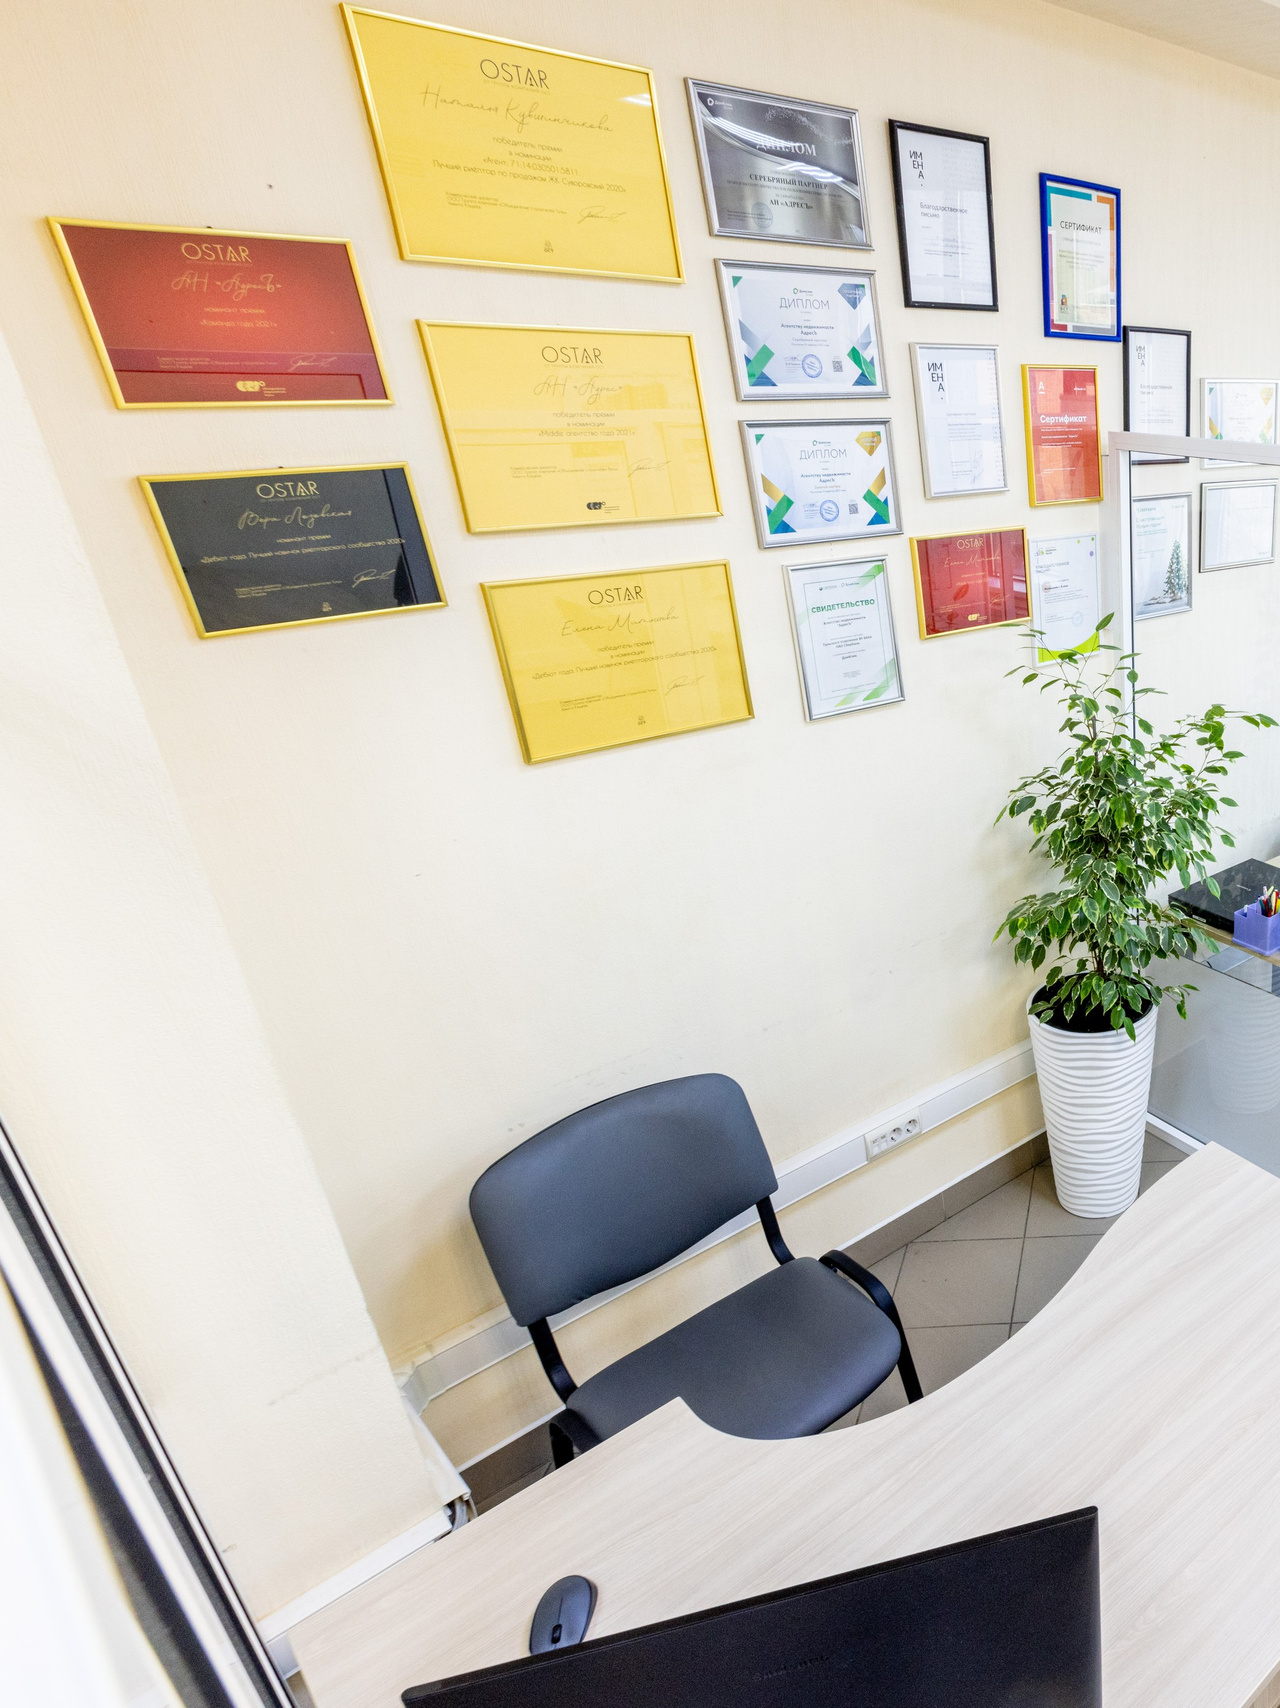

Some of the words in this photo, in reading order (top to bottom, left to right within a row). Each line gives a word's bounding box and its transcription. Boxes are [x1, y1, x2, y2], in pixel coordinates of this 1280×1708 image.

[480, 59, 550, 90] OSTAR
[492, 136, 536, 149] победитель
[1060, 220, 1102, 235] СЕРТИФИКАТ
[181, 242, 252, 263] OSTAR
[779, 297, 830, 310] ДИПЛОМ
[541, 346, 603, 364] OSTAR
[1040, 413, 1087, 425] Сертификат
[799, 448, 847, 460] ДИПЛОМ
[256, 481, 320, 499] OSTAR
[957, 537, 984, 549] OSTAR
[588, 586, 644, 605] OSTAR
[811, 599, 875, 613] СВИДЕТЕЛЬСТВО
